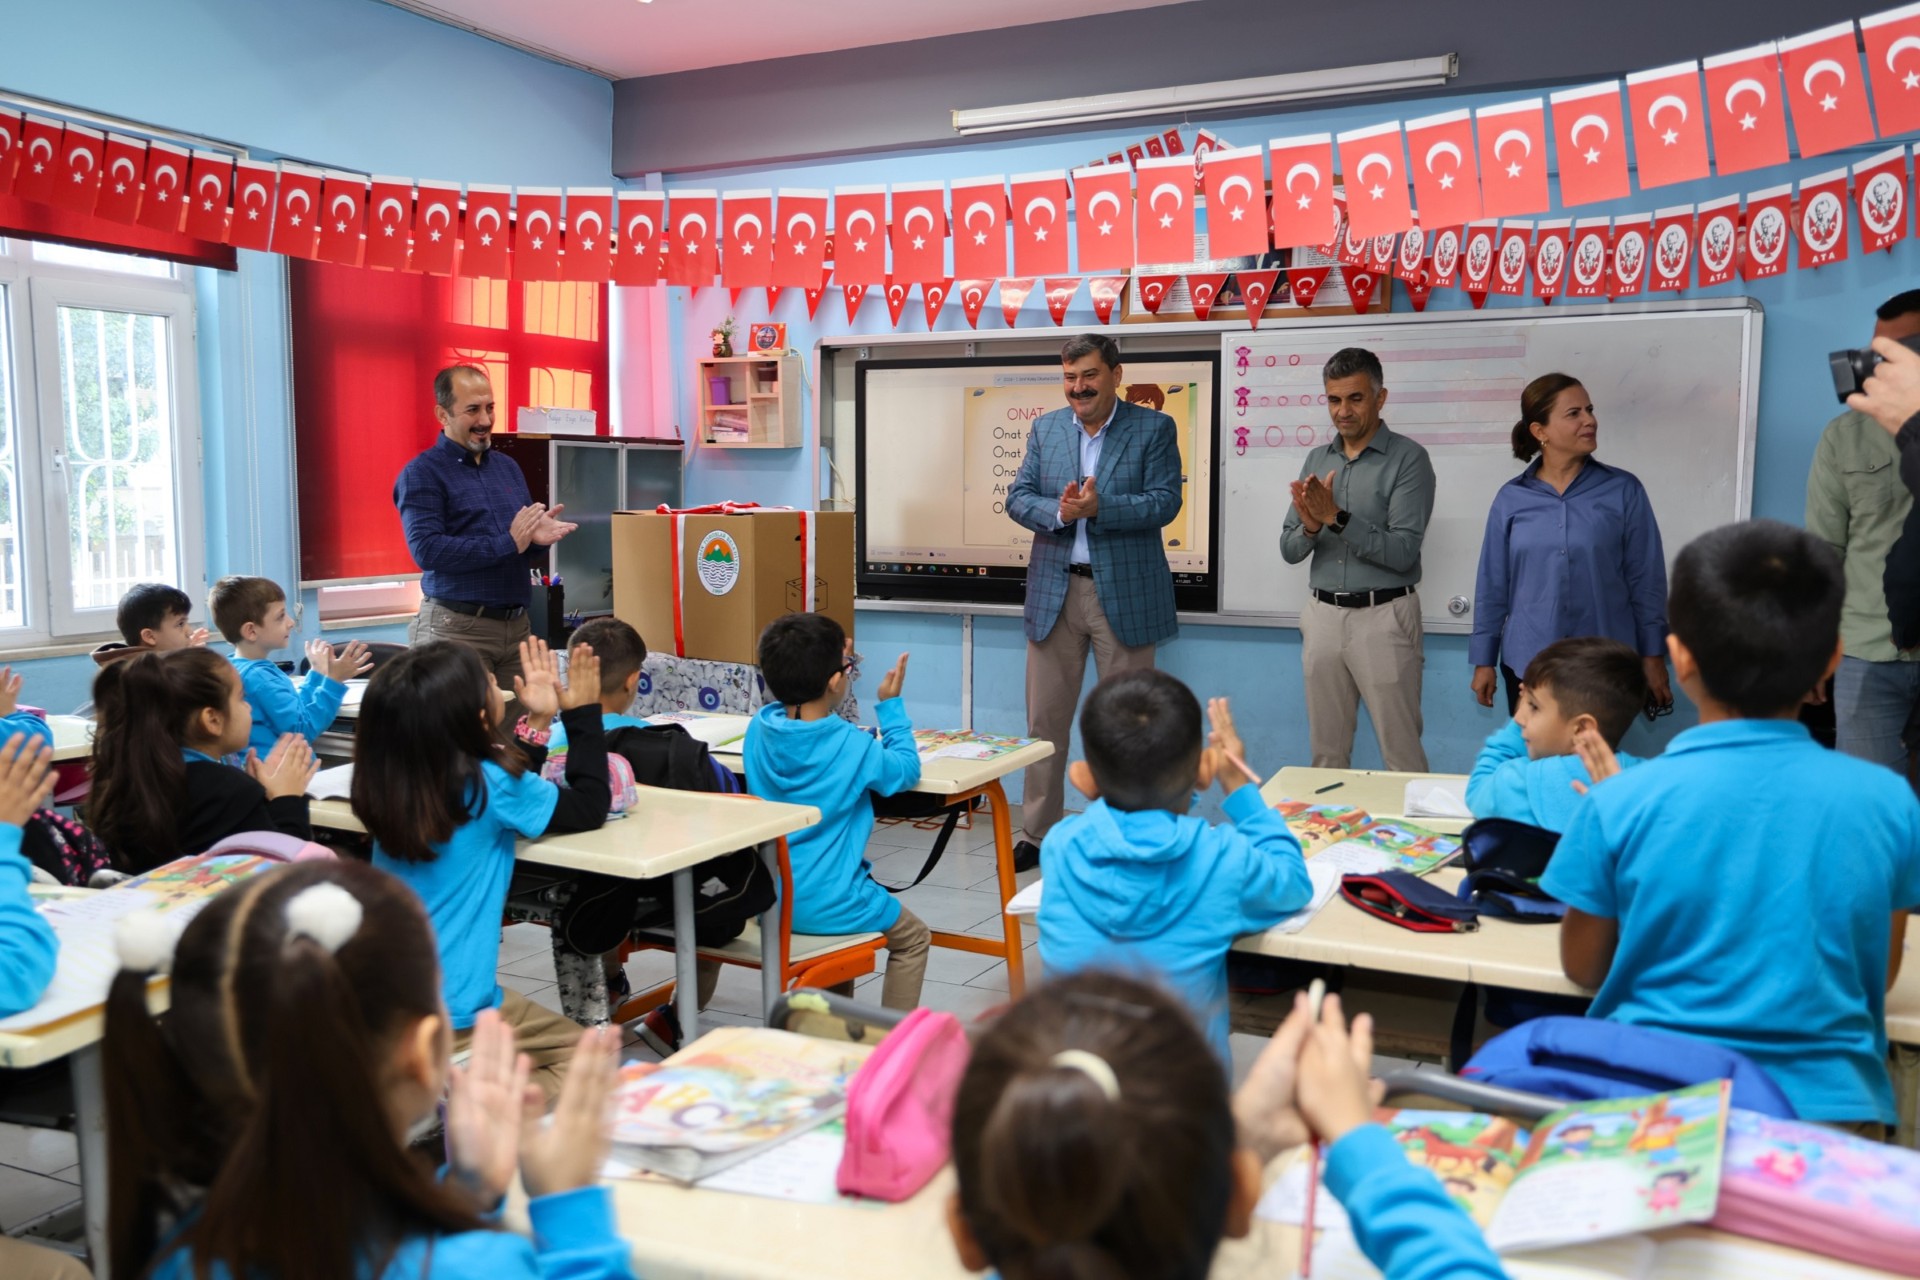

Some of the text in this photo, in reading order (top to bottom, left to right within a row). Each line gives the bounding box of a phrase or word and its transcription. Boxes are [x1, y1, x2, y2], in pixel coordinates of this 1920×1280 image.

[1876, 232, 1898, 247] ATA
[1345, 255, 1358, 263] ATA
[1812, 252, 1836, 264] ATA
[1757, 266, 1778, 275] ATA
[1709, 273, 1728, 282] ATA
[1660, 280, 1680, 288] ATA
[1006, 407, 1044, 421] ONAT
[992, 426, 1022, 440] Onat
[992, 446, 1021, 458] Onat
[992, 483, 1006, 495] At
